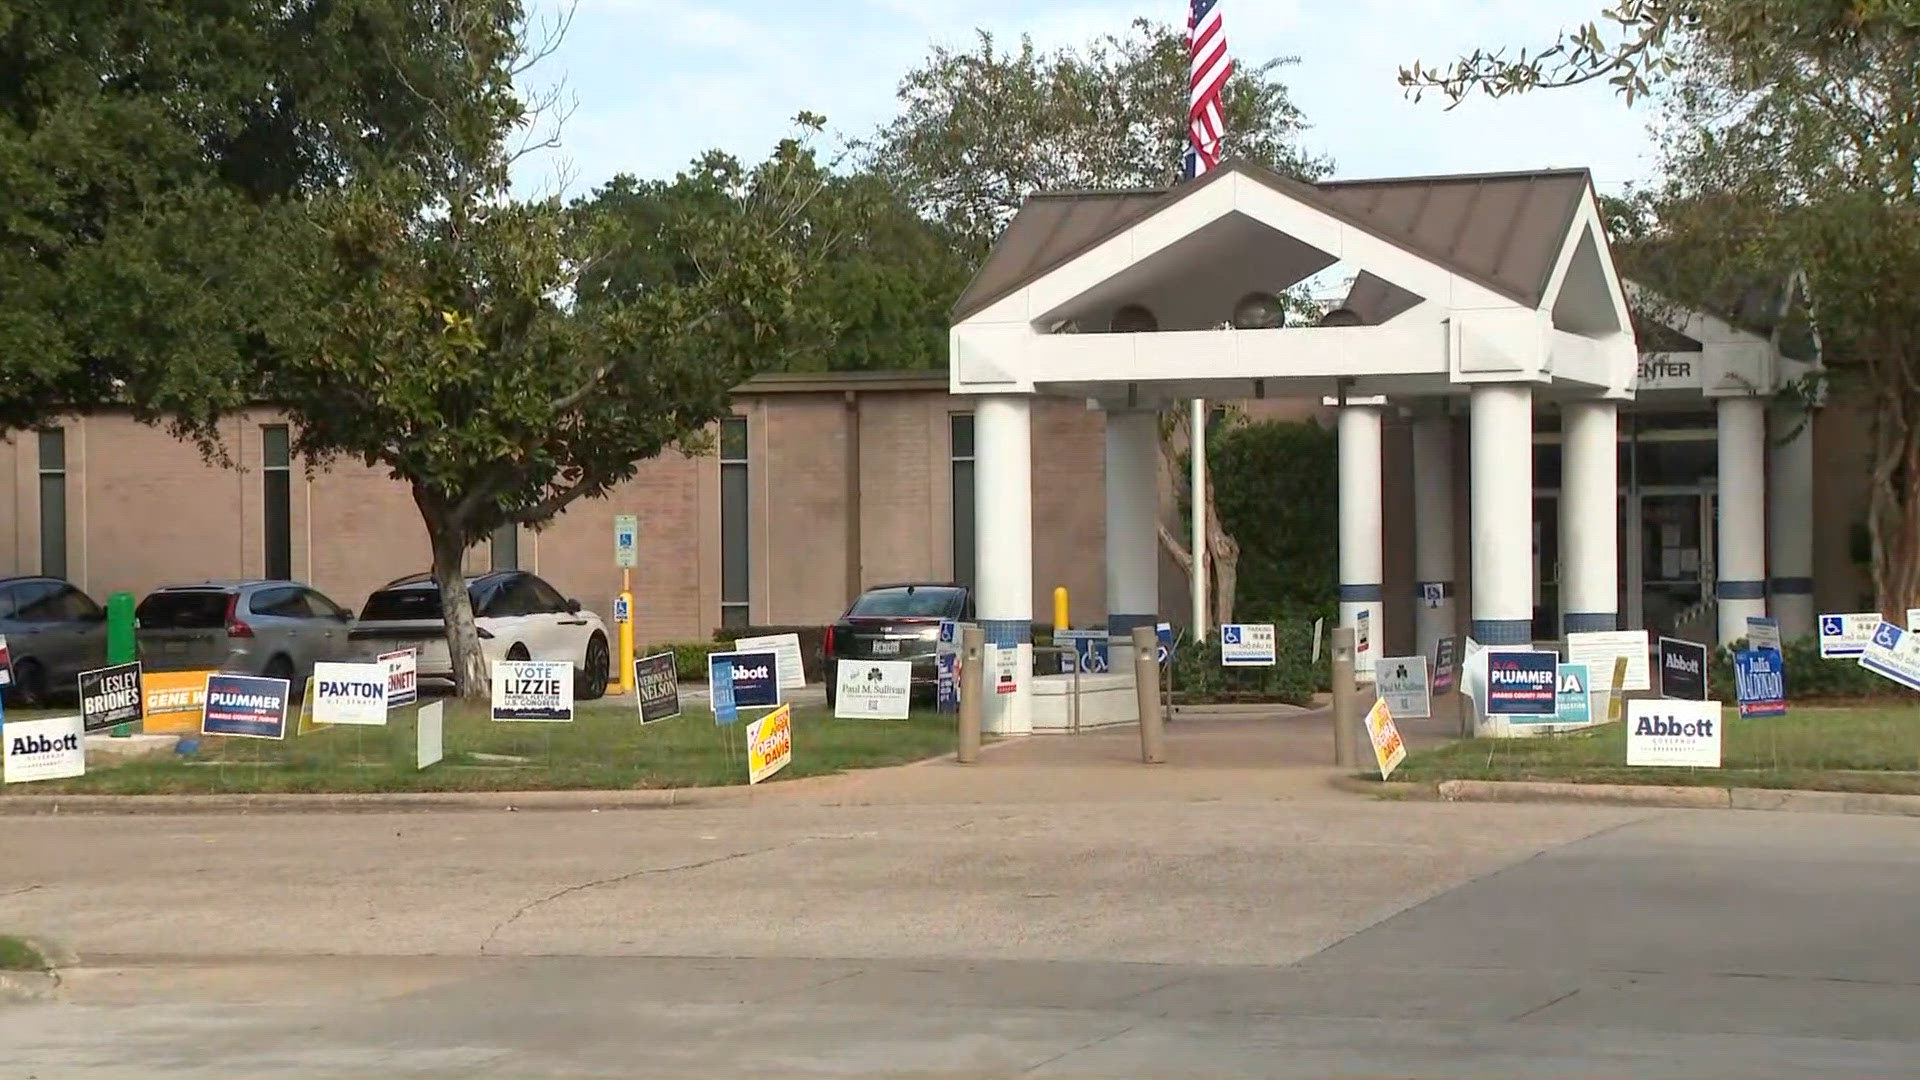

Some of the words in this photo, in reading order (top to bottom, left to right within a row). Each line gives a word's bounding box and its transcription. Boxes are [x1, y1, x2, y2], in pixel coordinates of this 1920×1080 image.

[514, 667, 552, 678] VOTE
[1666, 653, 1699, 675] Abbott
[1749, 657, 1770, 672] Julia
[100, 671, 138, 694] LESLEY
[1491, 670, 1553, 683] PLUMMER
[319, 681, 384, 700] PAXTON
[505, 679, 560, 695] LIZZIE
[641, 681, 676, 702] NELSON
[842, 683, 860, 694] Paul
[874, 685, 906, 694] Sullivan
[85, 688, 140, 715] BRIONES
[147, 692, 189, 707] GENE
[210, 692, 280, 709] PLUMMER
[1635, 715, 1713, 738] Abbott
[11, 733, 78, 756] Abbott
[765, 739, 790, 766] DAVIS
